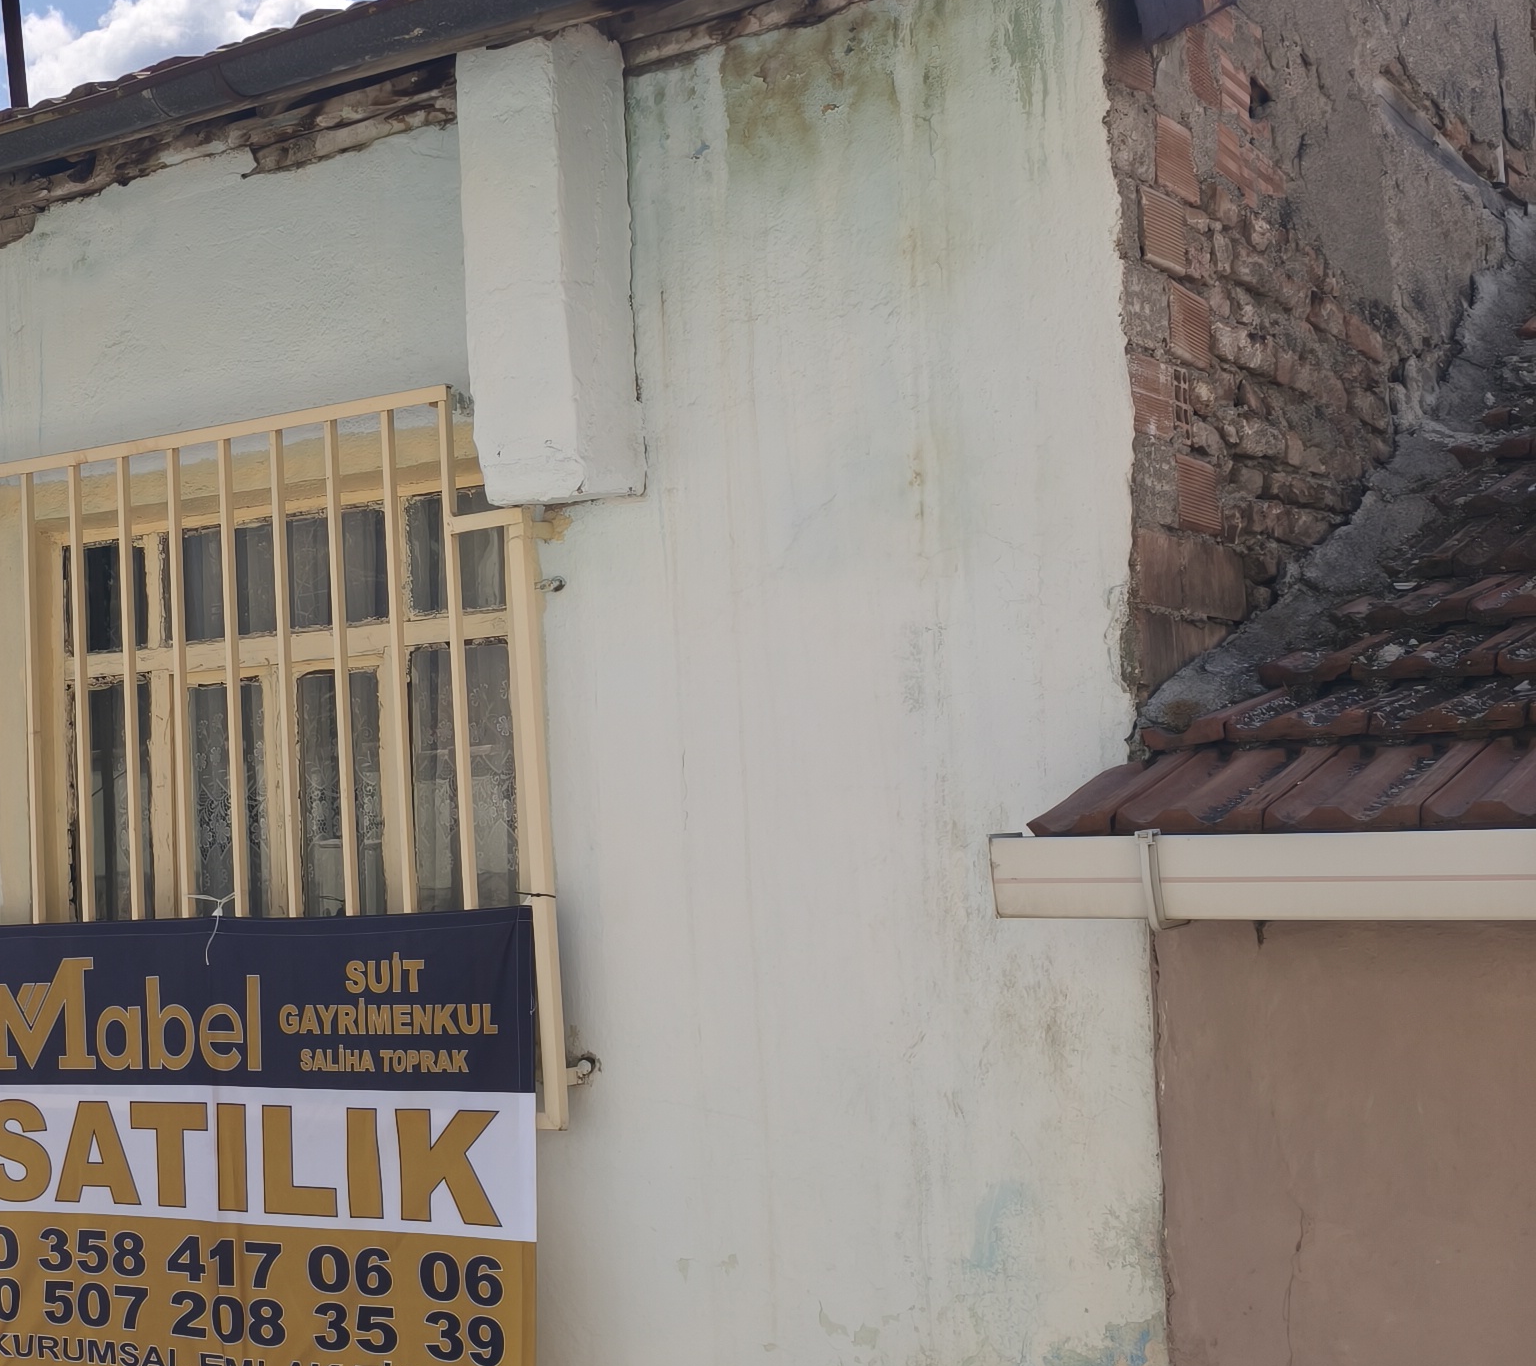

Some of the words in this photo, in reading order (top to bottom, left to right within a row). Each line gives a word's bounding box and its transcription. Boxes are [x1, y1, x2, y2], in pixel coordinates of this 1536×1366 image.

[344, 951, 425, 994] SUİT
[279, 997, 499, 1035] GAYRİMENKUL
[300, 1044, 376, 1072] SALİHA
[379, 1049, 470, 1073] TOPRAK
[37, 1227, 147, 1278] 358
[166, 1235, 283, 1290] 417
[306, 1244, 394, 1298] 06
[418, 1250, 505, 1308] 06
[42, 1279, 150, 1331] 507
[169, 1289, 288, 1348] 208
[313, 1301, 399, 1355] 35
